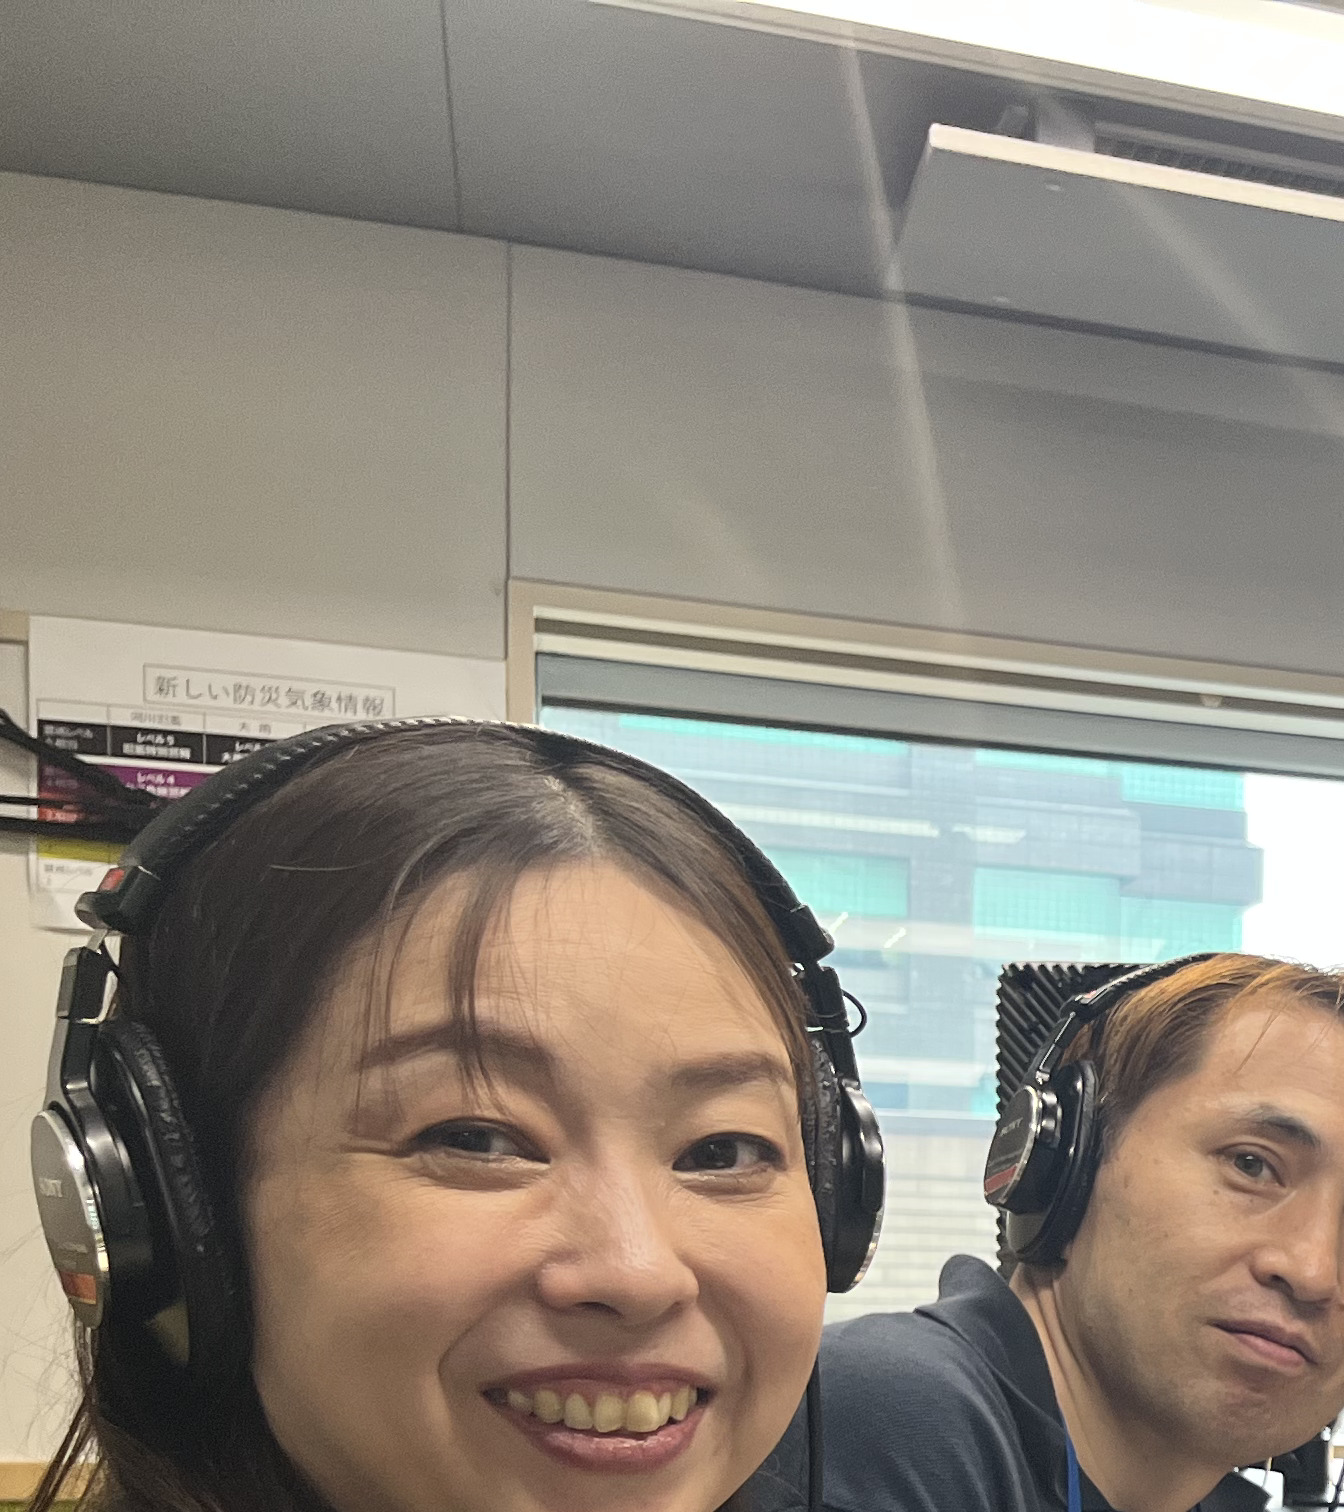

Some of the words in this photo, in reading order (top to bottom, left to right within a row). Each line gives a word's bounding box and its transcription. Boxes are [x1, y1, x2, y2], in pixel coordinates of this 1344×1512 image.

[153, 674, 386, 718] 新しい防災気象情報
